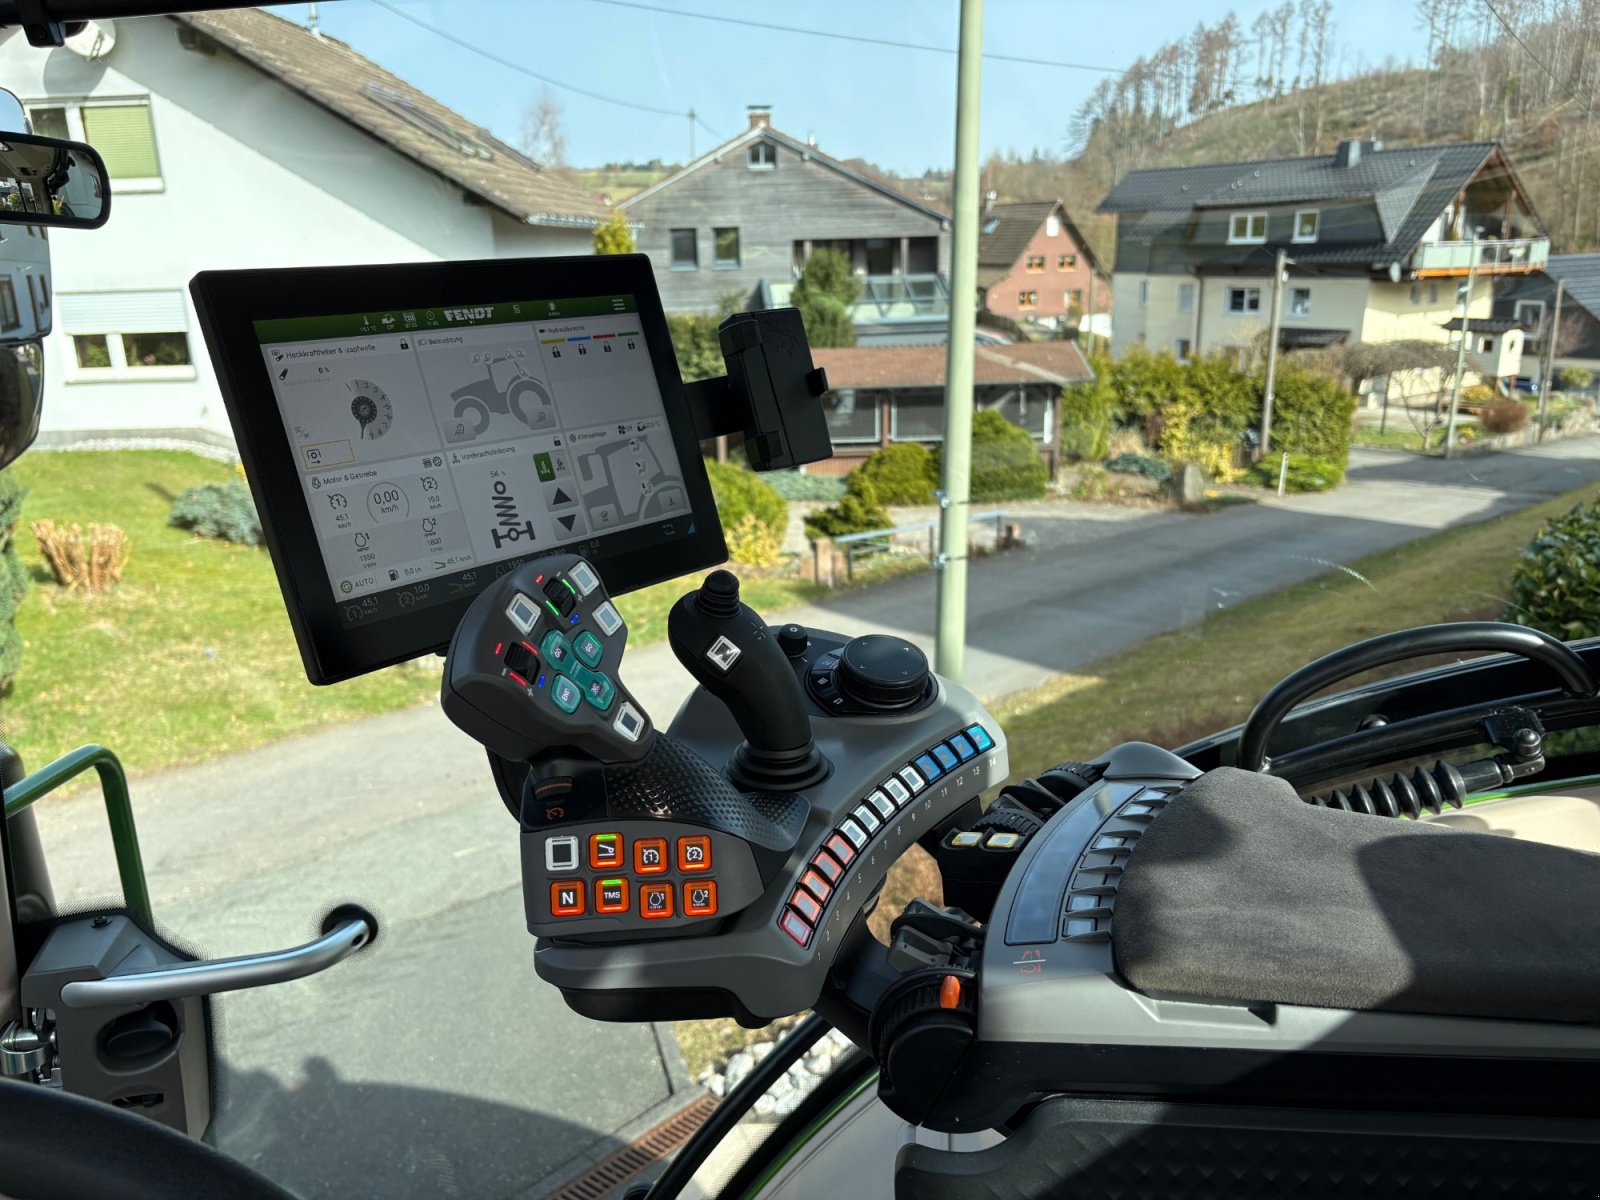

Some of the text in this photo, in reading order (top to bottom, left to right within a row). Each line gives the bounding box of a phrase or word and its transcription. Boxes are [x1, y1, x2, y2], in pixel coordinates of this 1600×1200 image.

[443, 306, 494, 322] FENDT
[428, 336, 464, 345] Beleuchtung
[286, 348, 337, 359] Heckkraftheber
[323, 470, 378, 485] Motor & Getriebe
[490, 470, 499, 478] 54
[426, 480, 434, 489] 2
[373, 489, 400, 506] 0,00
[380, 504, 400, 514] km/h
[335, 513, 349, 522] 45,1
[431, 518, 438, 526] 2
[359, 553, 376, 562] 1550
[462, 571, 478, 581] 45,1
[354, 577, 374, 588] AUTO
[413, 583, 430, 595] 10,0
[362, 596, 379, 608] 45,1
[585, 643, 593, 652] GO
[554, 648, 563, 658] GO
[989, 756, 997, 768] 14
[973, 766, 980, 776] 13
[956, 776, 964, 787] 12
[941, 787, 948, 798] 11
[925, 799, 932, 810] 10
[692, 850, 698, 859] 2
[562, 892, 574, 904] N
[604, 891, 621, 900] TMS
[703, 890, 709, 898] 2
